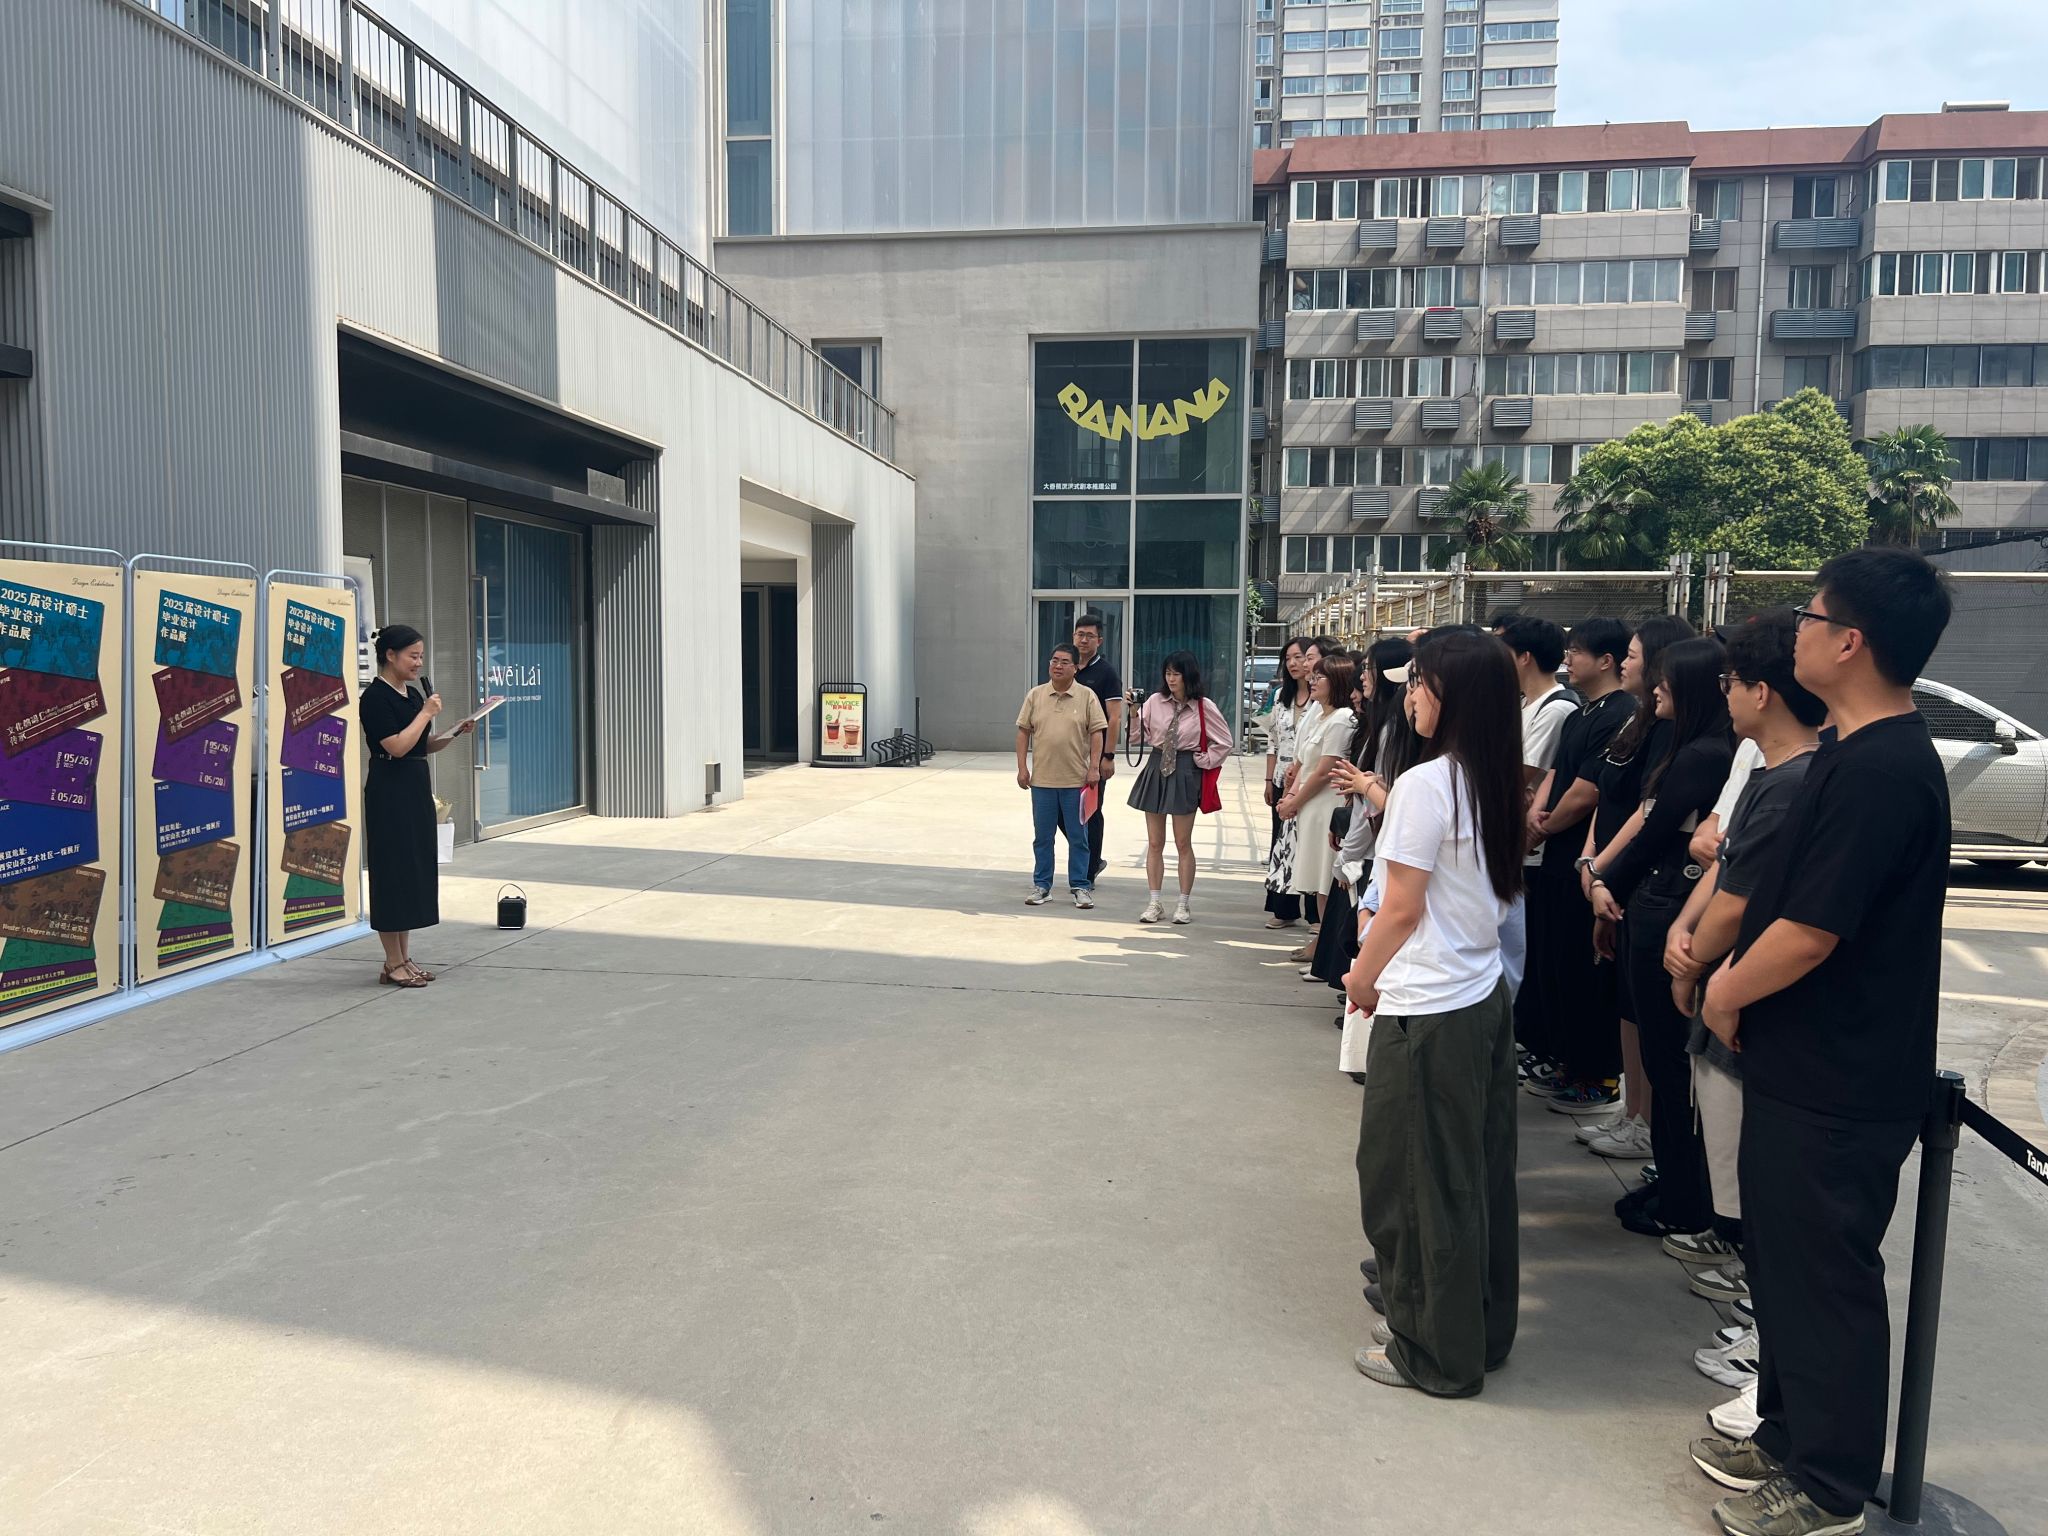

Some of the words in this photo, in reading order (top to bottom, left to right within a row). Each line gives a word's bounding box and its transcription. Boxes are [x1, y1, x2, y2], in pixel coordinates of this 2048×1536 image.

[1057, 377, 1230, 441] BANANA
[0, 588, 89, 620] 2025届设计硕士
[0, 604, 45, 626] 毕业设计
[163, 597, 231, 626] 2025届设计硕士
[162, 611, 197, 630] 毕业设计
[289, 605, 337, 632] 2025届设计硕士
[0, 621, 31, 641] 作品展
[160, 627, 187, 643] 作品展
